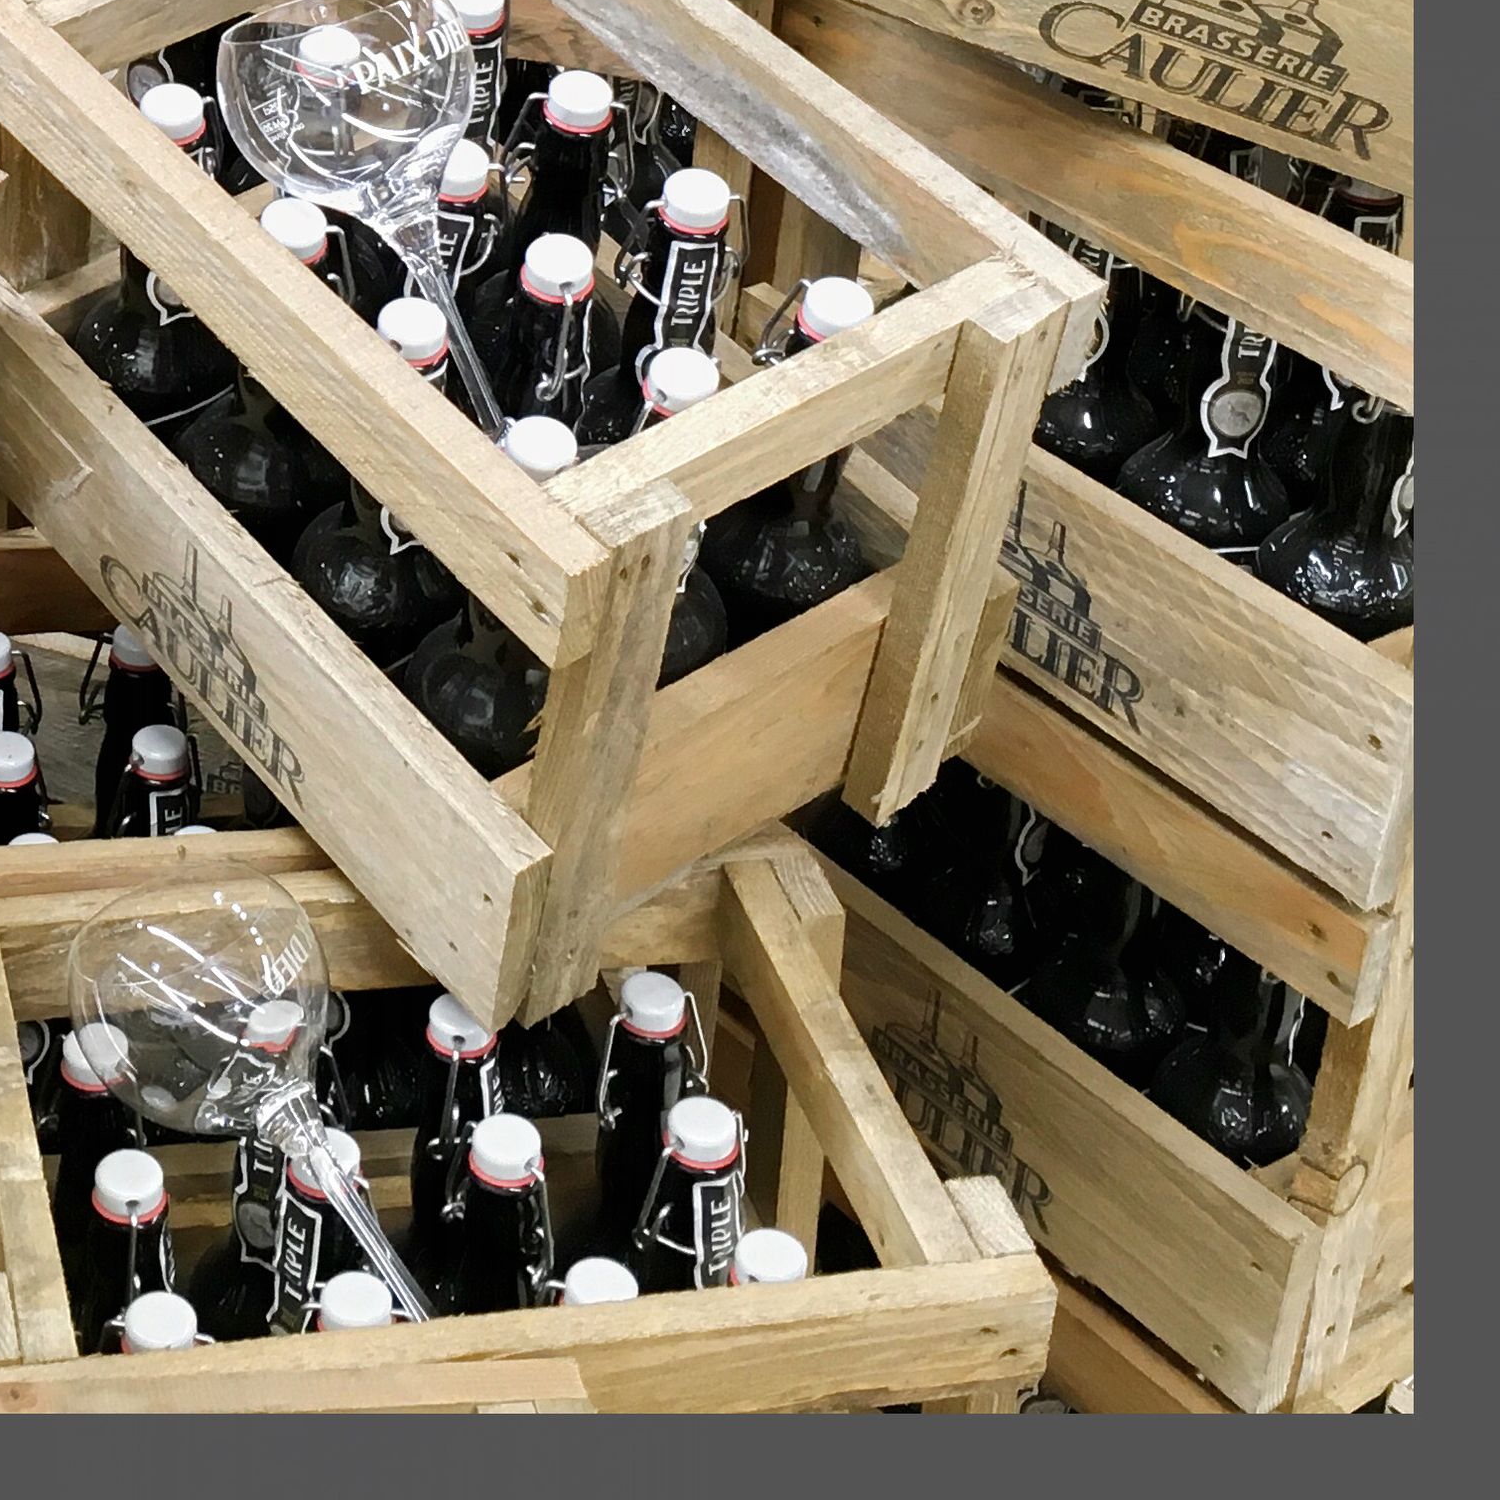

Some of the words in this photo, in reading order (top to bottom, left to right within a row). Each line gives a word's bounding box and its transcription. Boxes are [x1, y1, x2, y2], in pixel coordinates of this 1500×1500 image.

[349, 41, 432, 96] PAIX
[1038, 0, 1394, 161] CAULIER
[1139, 5, 1339, 91] BRASSERIE
[670, 258, 707, 327] TRIPLE
[100, 554, 306, 811] CAULIER
